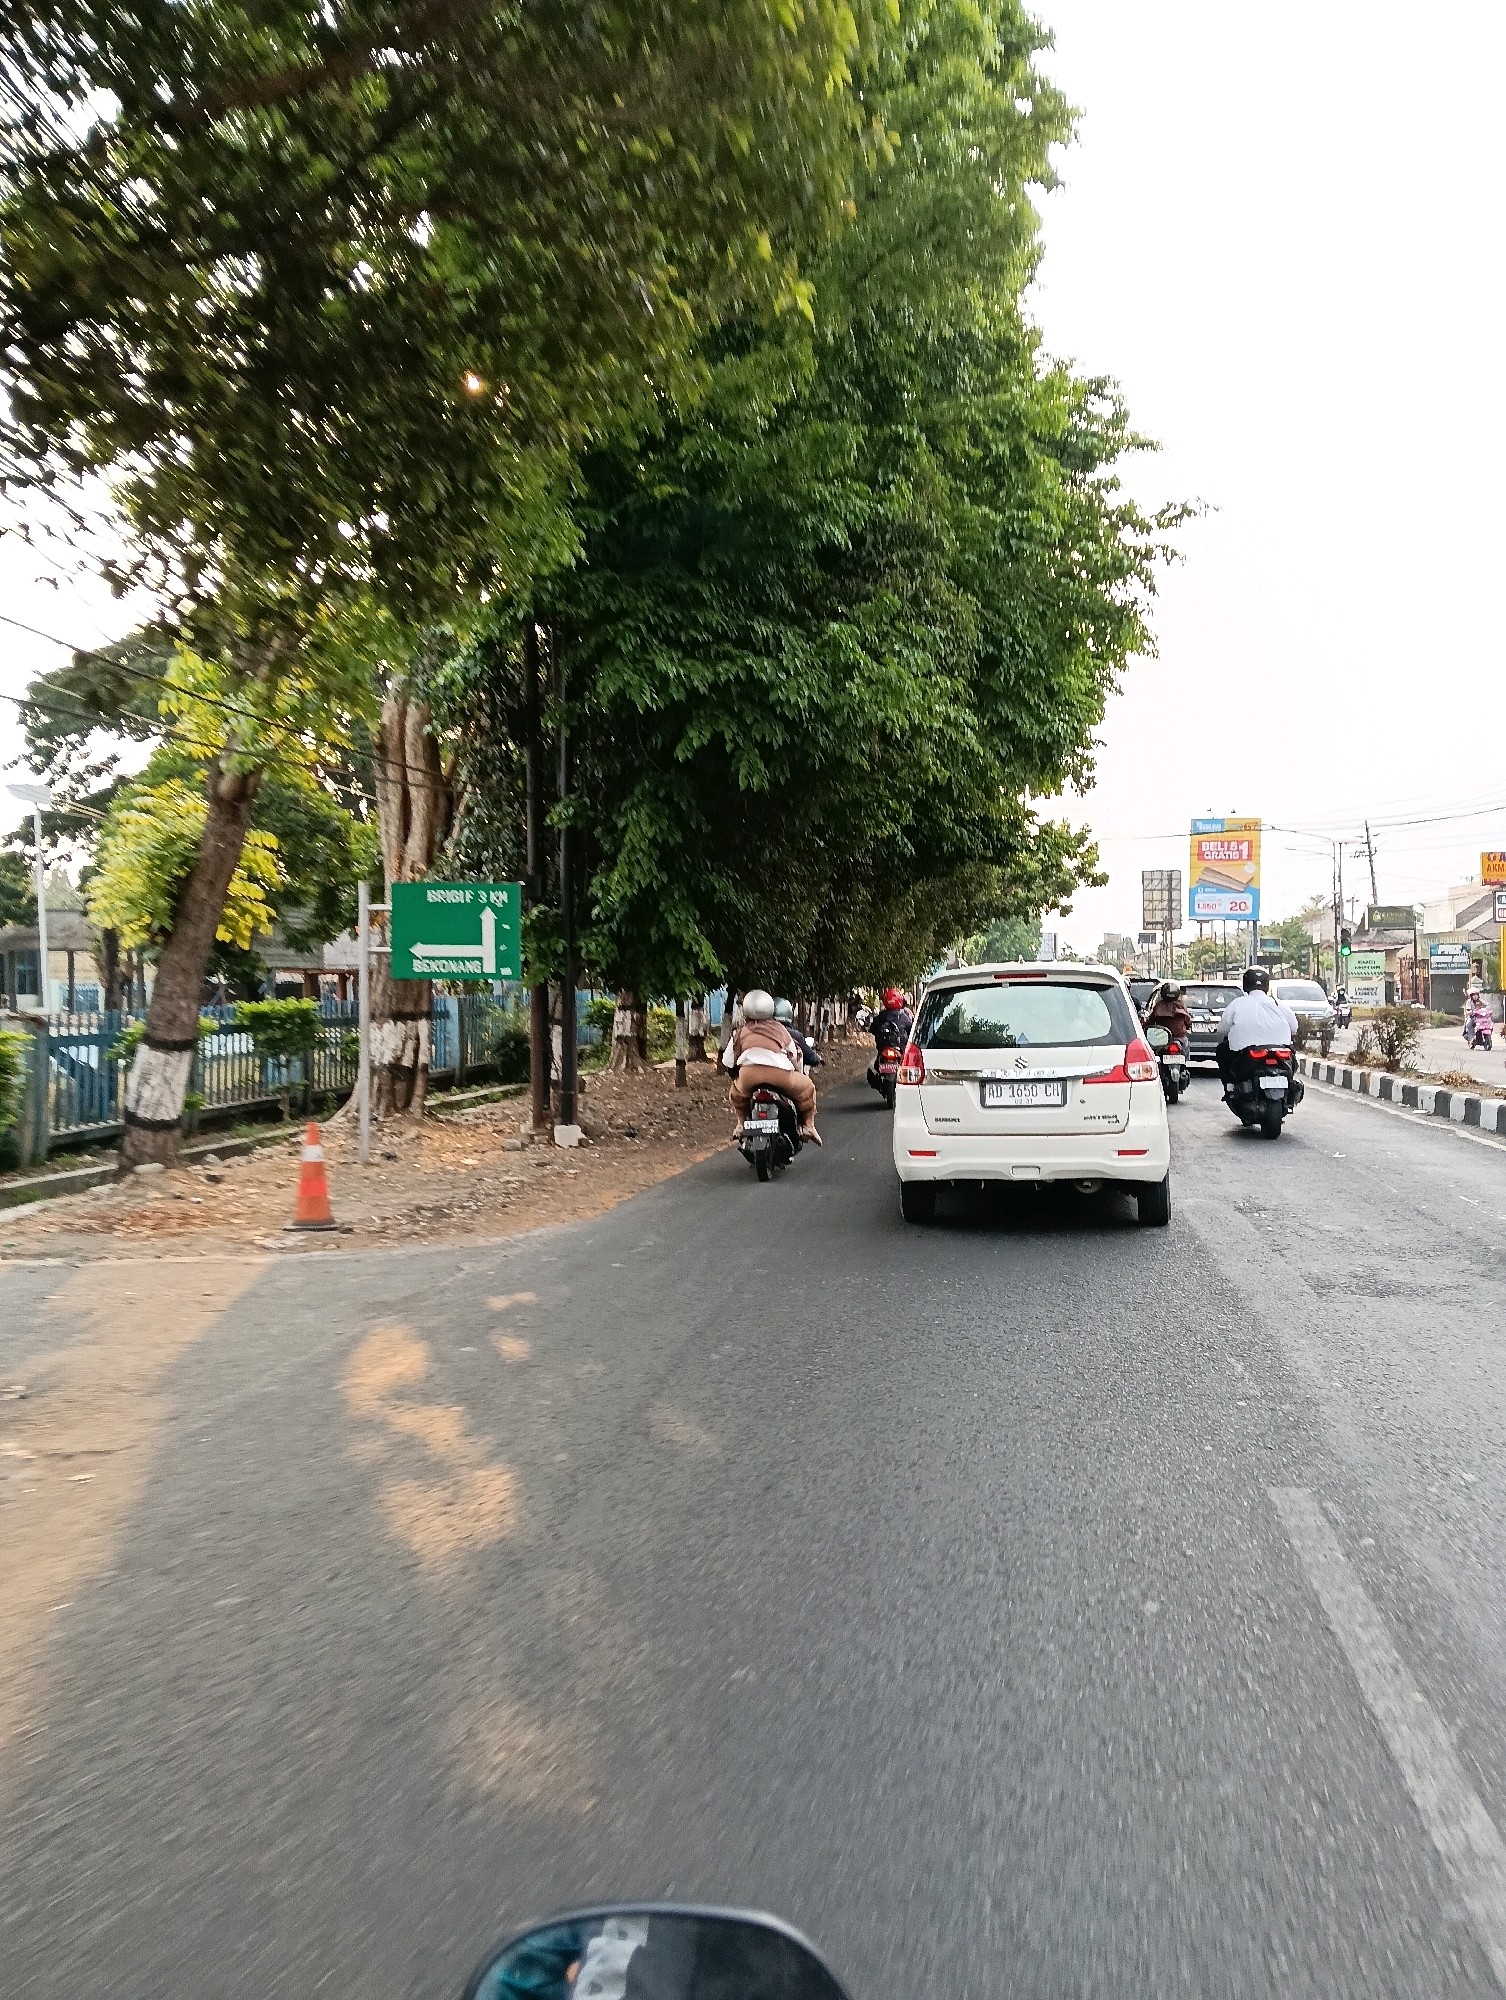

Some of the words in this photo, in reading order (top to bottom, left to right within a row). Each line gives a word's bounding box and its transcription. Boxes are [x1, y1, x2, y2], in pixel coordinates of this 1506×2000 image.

[426, 889, 475, 904] BRIGIF
[988, 1083, 1003, 1099] AD
[1008, 1083, 1038, 1098] 1650
[1044, 1082, 1060, 1097] CH
